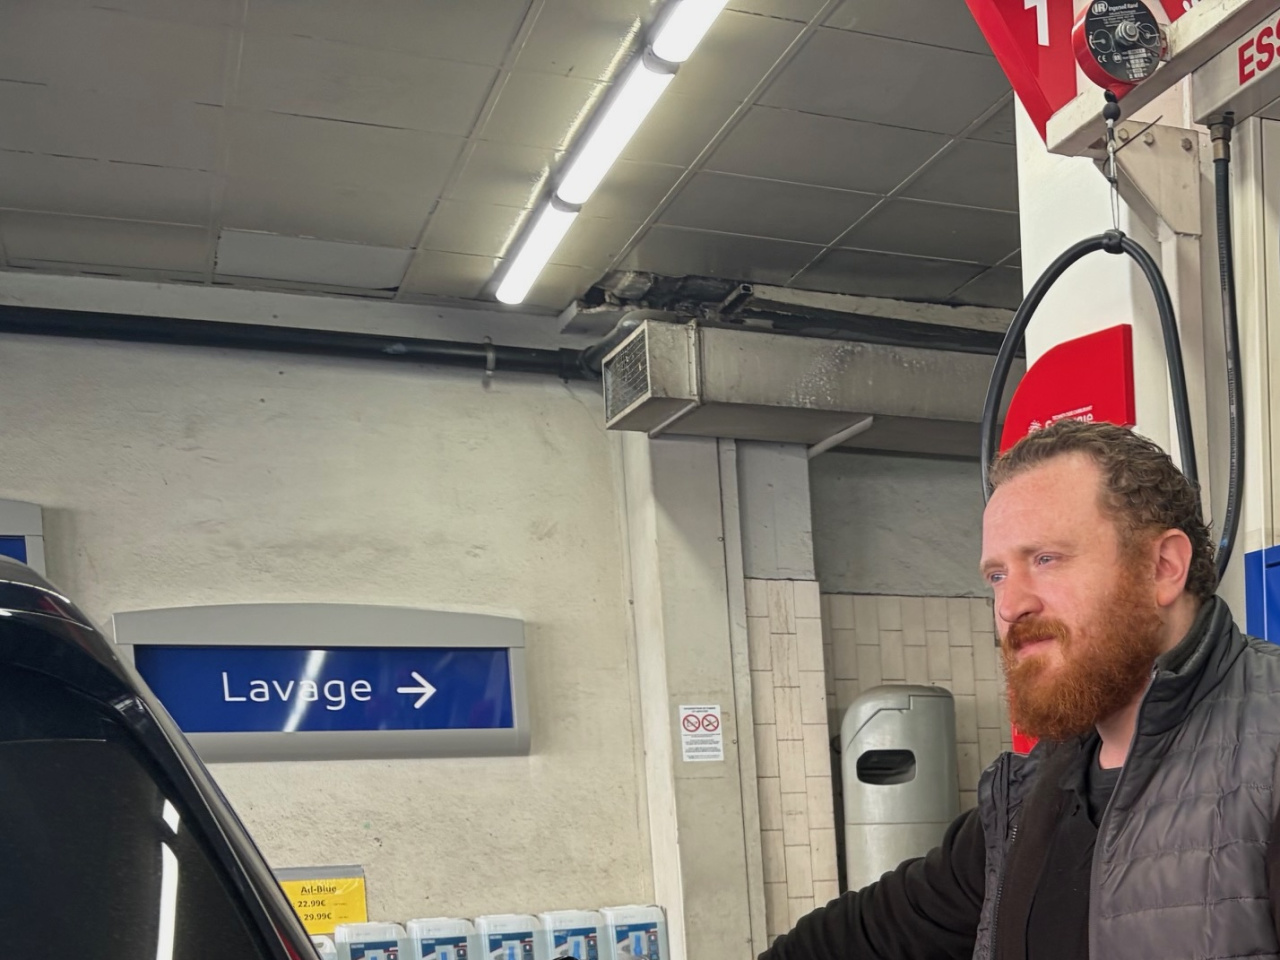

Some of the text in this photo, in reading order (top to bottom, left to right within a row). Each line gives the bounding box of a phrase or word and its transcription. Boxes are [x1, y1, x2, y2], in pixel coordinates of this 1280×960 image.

[221, 672, 373, 711] Lavage
[301, 886, 337, 894] Ad-Blue
[298, 900, 326, 908] 22.99€
[304, 913, 332, 921] 29.99€
